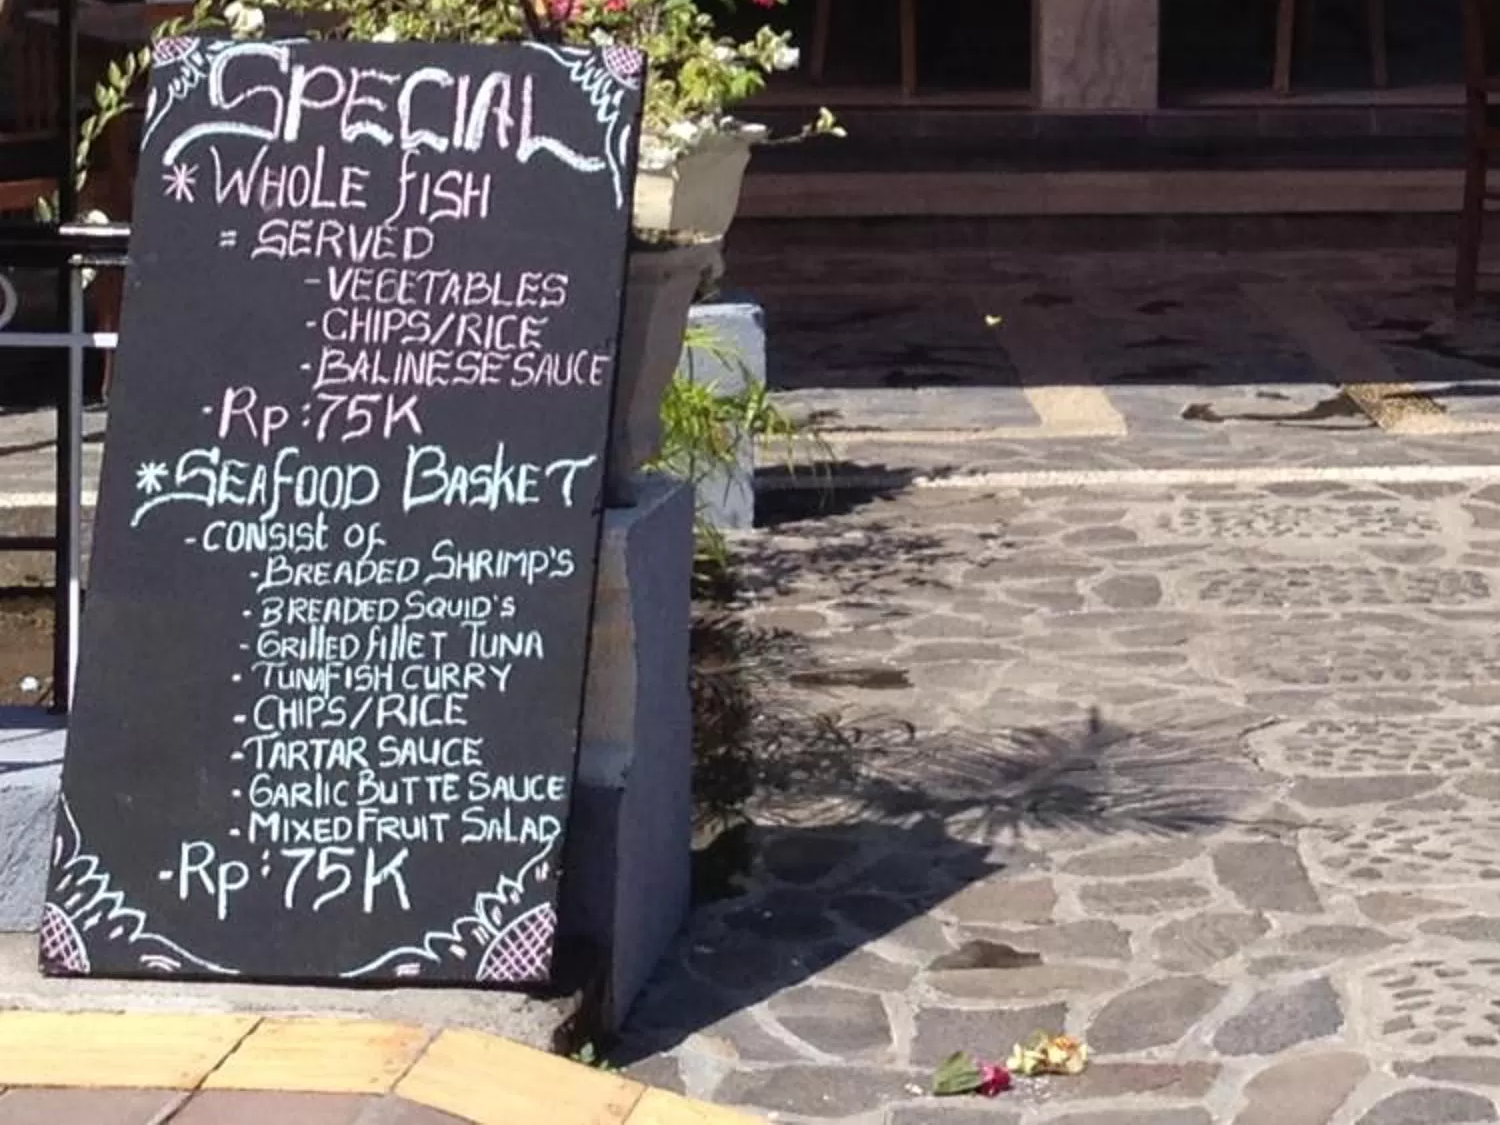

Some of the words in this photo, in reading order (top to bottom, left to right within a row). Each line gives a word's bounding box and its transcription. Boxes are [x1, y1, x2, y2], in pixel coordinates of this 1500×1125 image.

[163, 42, 605, 172] SPECIAL
[210, 145, 370, 208] WHOLE
[252, 220, 433, 259] SERVED
[328, 266, 568, 307] VEGETABLES
[322, 307, 548, 351] CHIPS/RICE
[314, 347, 501, 390] BALINESE
[511, 354, 609, 387] SAUCE
[257, 555, 419, 593] BREADED
[425, 540, 574, 585] SHRIMP'S
[261, 597, 398, 627] BREADED
[402, 590, 516, 621] SQUID'S
[461, 621, 544, 659] TUNA
[401, 664, 512, 692] CURRY
[253, 694, 469, 730] CHIPS/RICE
[243, 731, 368, 770] TARTAR
[379, 737, 483, 767] SAUCE
[469, 772, 566, 801] SAUCE
[249, 811, 351, 842] MIXED
[358, 807, 450, 842] FRUIT
[461, 807, 561, 843] SALAD
